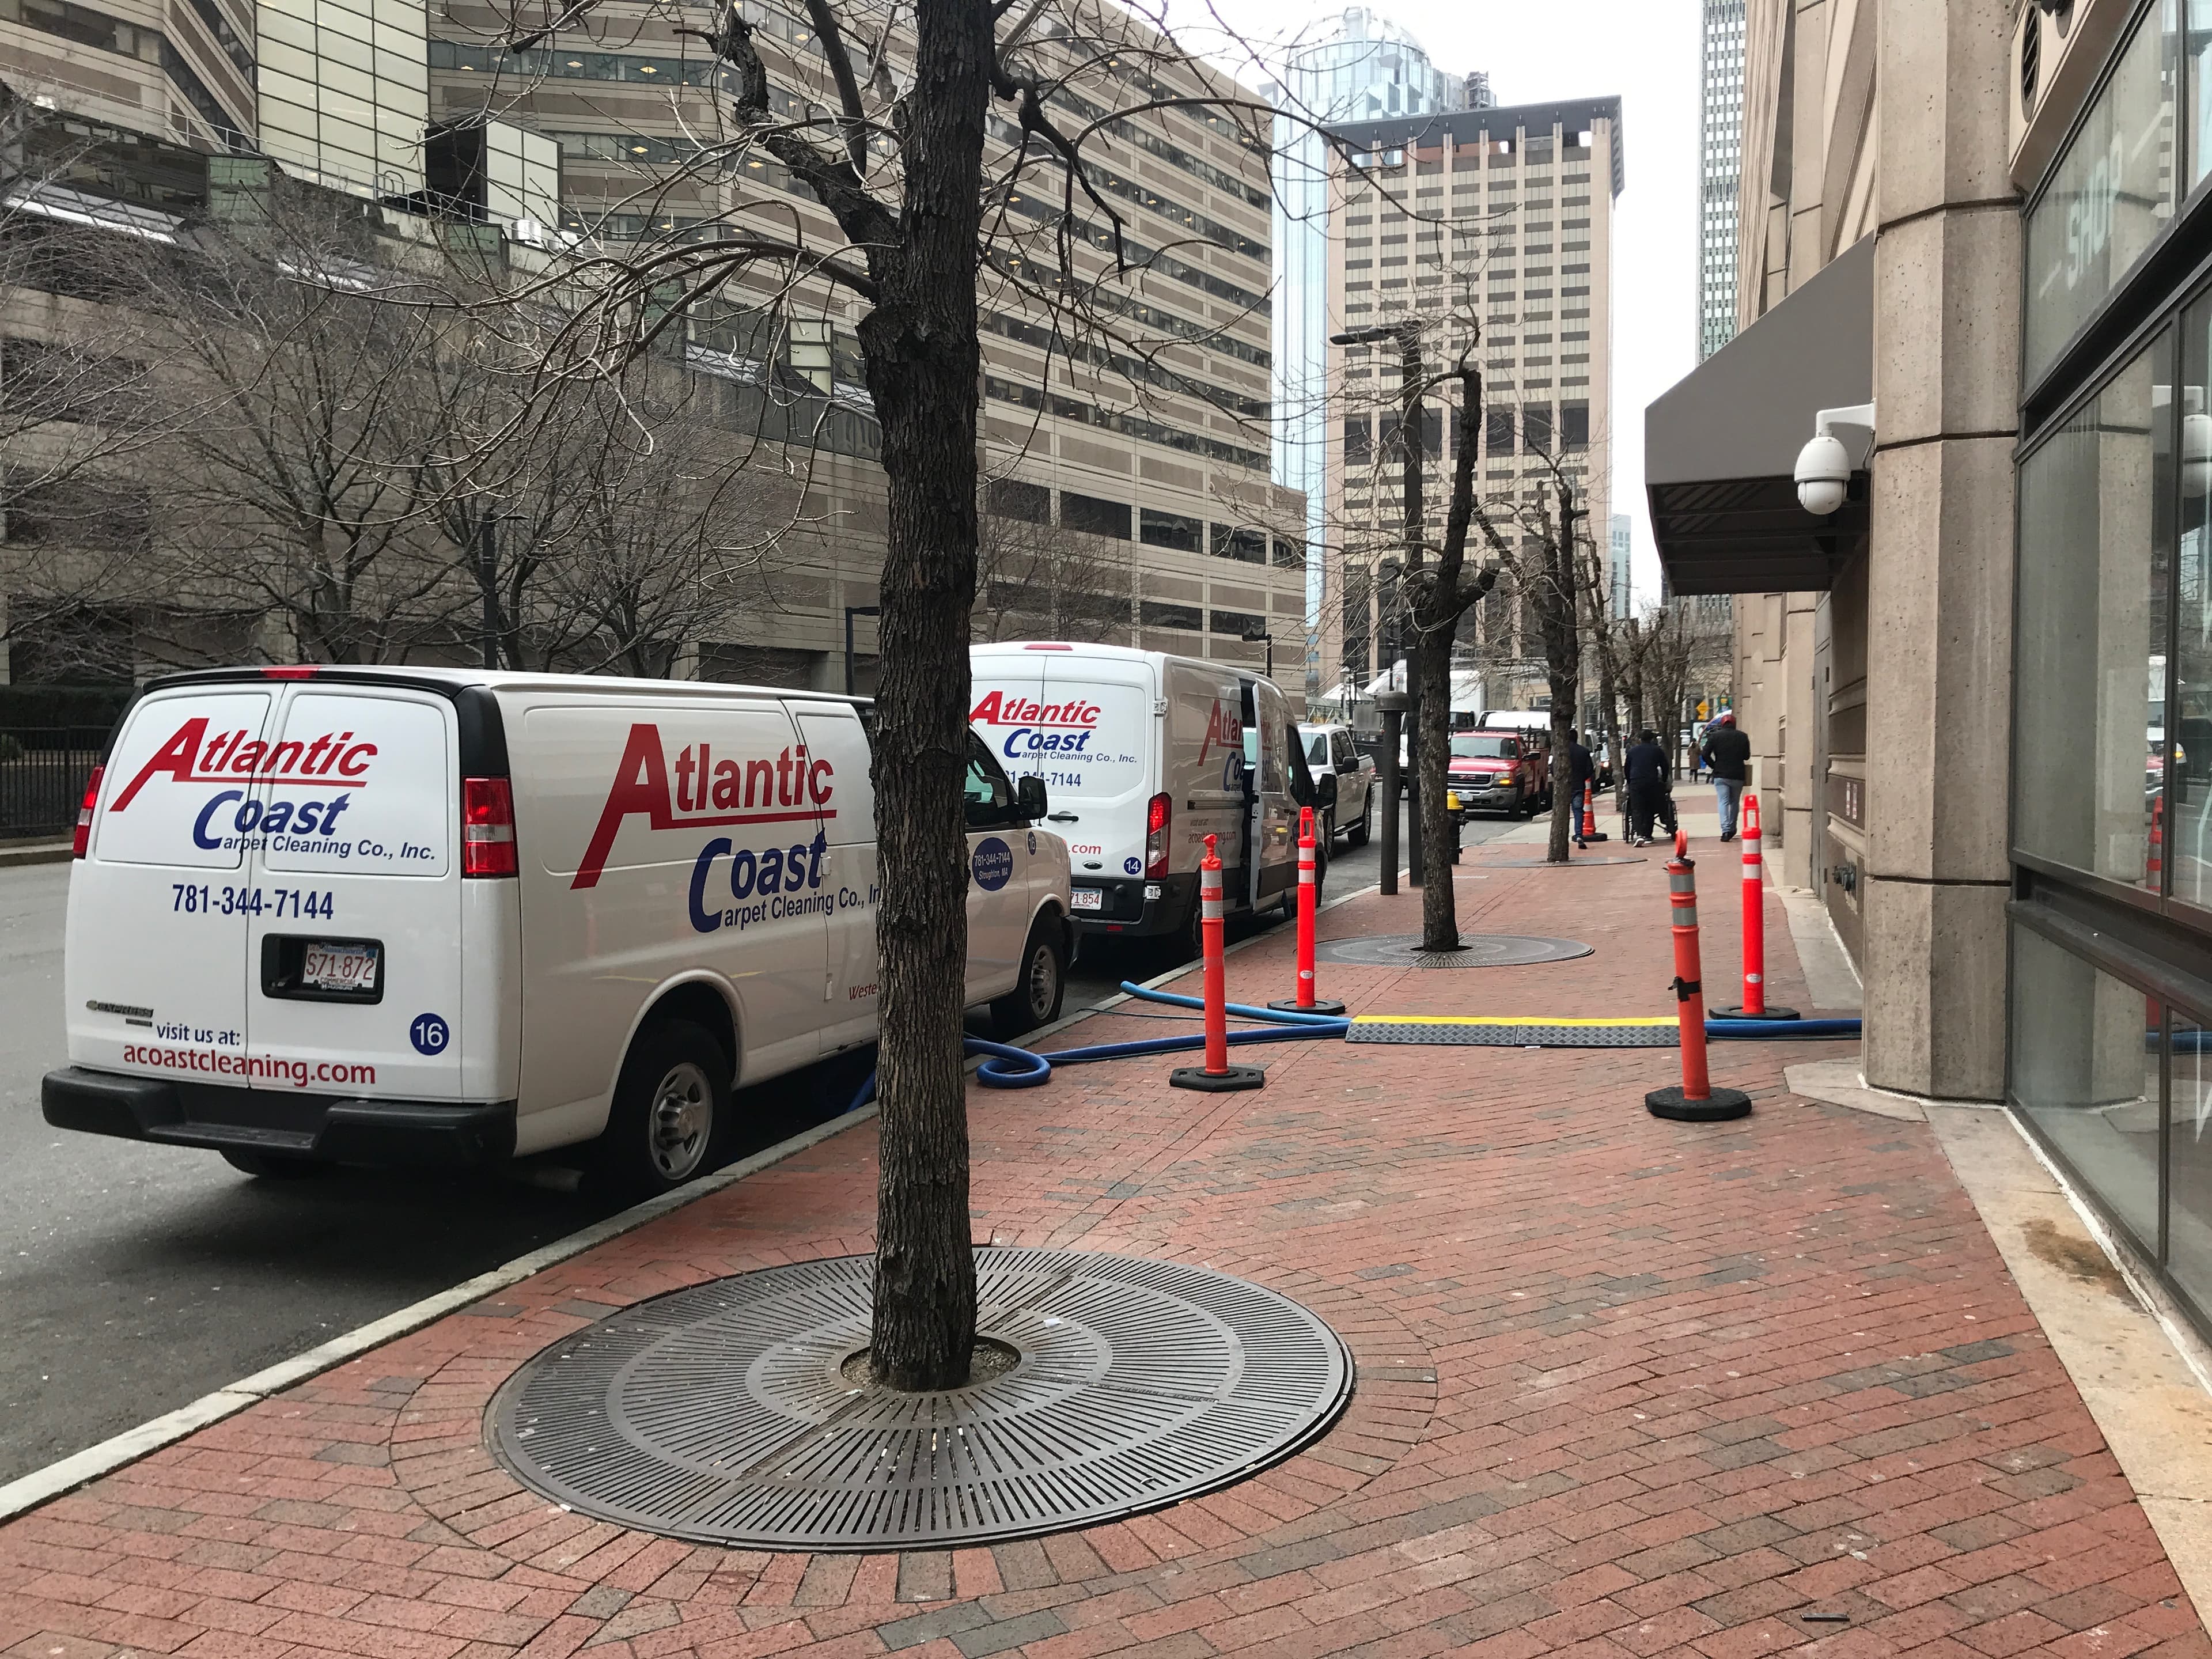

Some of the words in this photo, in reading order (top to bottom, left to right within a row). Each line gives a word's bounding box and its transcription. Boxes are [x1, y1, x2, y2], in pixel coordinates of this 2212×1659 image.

[2067, 131, 2123, 290] SHOP
[969, 691, 1101, 724] Atlantic
[1003, 728, 1090, 758] Coast
[1050, 751, 1093, 762] Cleaning
[1096, 753, 1115, 763] Co.,
[1119, 754, 1137, 763] Inc.
[109, 718, 378, 812] Atlantic
[193, 790, 351, 850] Coast
[570, 724, 834, 890] Atlantic
[273, 835, 351, 858] Cleaning
[357, 840, 394, 859] Co.,
[400, 842, 435, 860] Inc.
[1029, 836, 1036, 850] 16
[974, 851, 1010, 867] 781-344-7144
[1002, 867, 1008, 876] MA
[1126, 859, 1139, 872] 14
[688, 828, 827, 933] Coast
[173, 884, 334, 920] 781-344-7144
[771, 891, 834, 919] Cleaning
[839, 887, 864, 908] Co.,
[157, 1022, 190, 1041] visit
[194, 1028, 214, 1044] us
[218, 1029, 241, 1046] at:
[415, 1021, 444, 1047] 16
[123, 1044, 376, 1088] acoastcleaning.com
